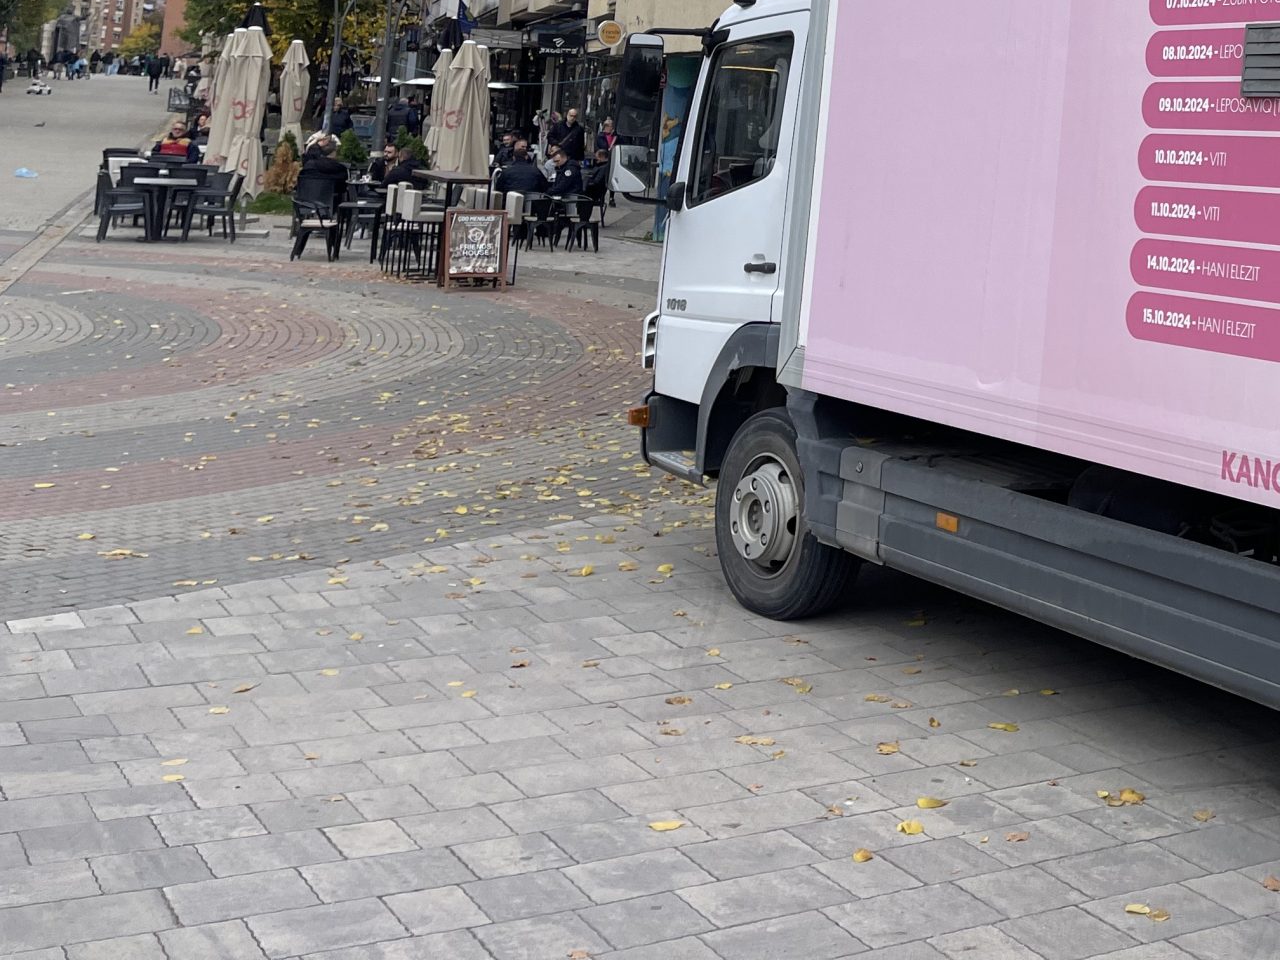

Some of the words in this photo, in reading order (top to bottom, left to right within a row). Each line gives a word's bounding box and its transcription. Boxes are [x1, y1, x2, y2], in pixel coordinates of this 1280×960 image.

[1163, 45, 1213, 60] 08.10.2024
[1159, 98, 1209, 112] 09.10.2024
[1216, 98, 1271, 113] LEPOSAVIQ
[1155, 150, 1202, 165] 10.10.2024
[1210, 152, 1226, 166] VITI
[1152, 202, 1196, 219] 11.10.2024
[1203, 206, 1219, 220] VITI
[1147, 255, 1195, 274] 14.10.2024
[1202, 261, 1225, 277] HAN
[1226, 264, 1229, 278] I
[1231, 264, 1260, 281] ELEZIT
[666, 298, 687, 311] 1018
[1143, 308, 1190, 328] 15.10.2024
[1198, 317, 1220, 333] HAN
[1222, 320, 1224, 334] I
[1226, 320, 1256, 338] ELEZIT
